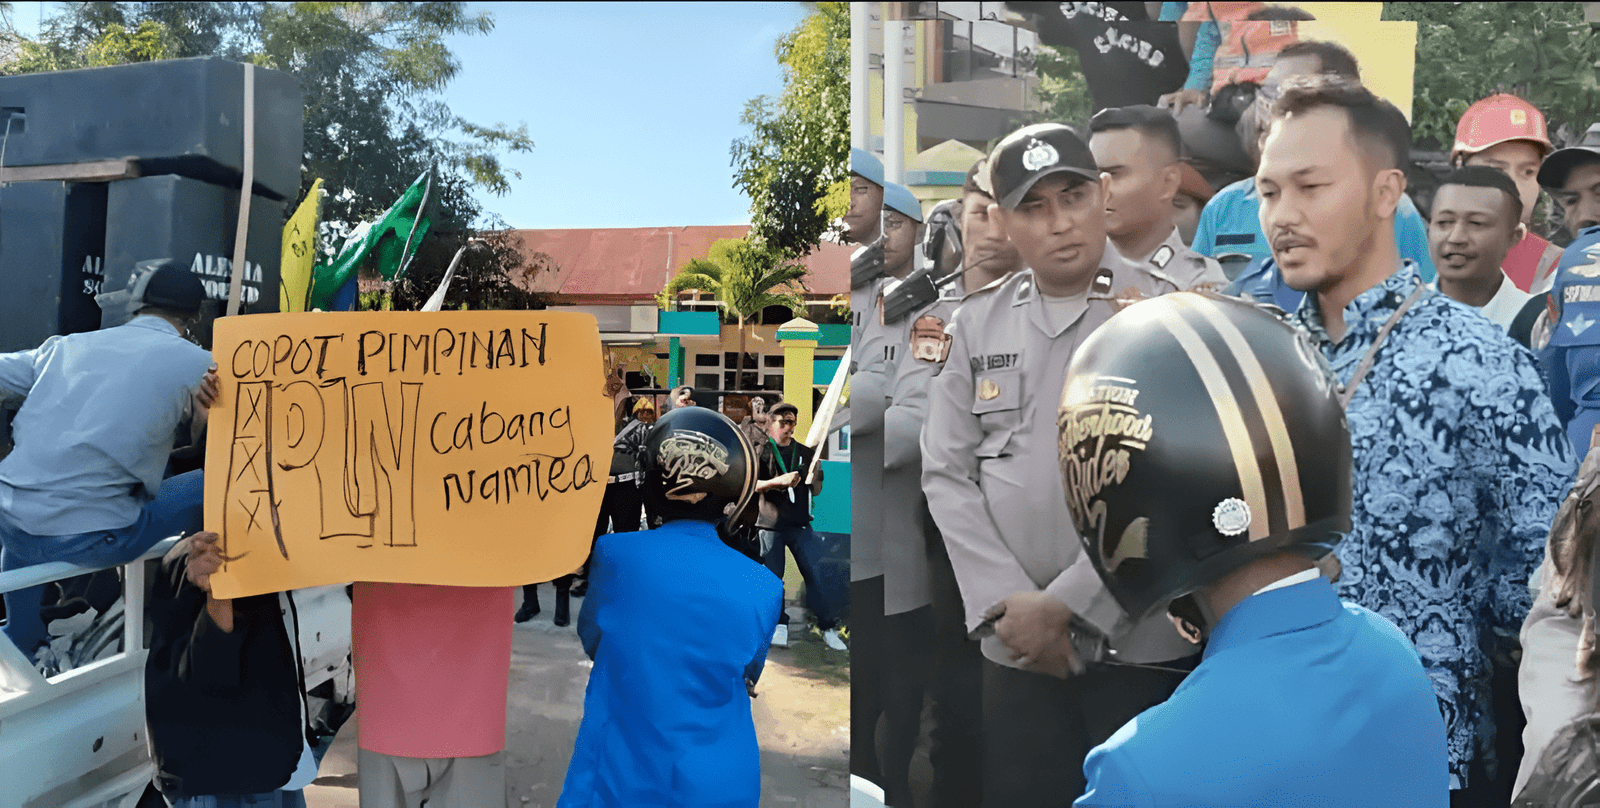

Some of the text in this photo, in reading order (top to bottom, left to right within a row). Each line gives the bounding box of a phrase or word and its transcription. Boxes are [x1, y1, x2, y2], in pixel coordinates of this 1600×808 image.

[232, 322, 549, 379] COPOT PIMPINAN
[269, 377, 424, 548] PLN
